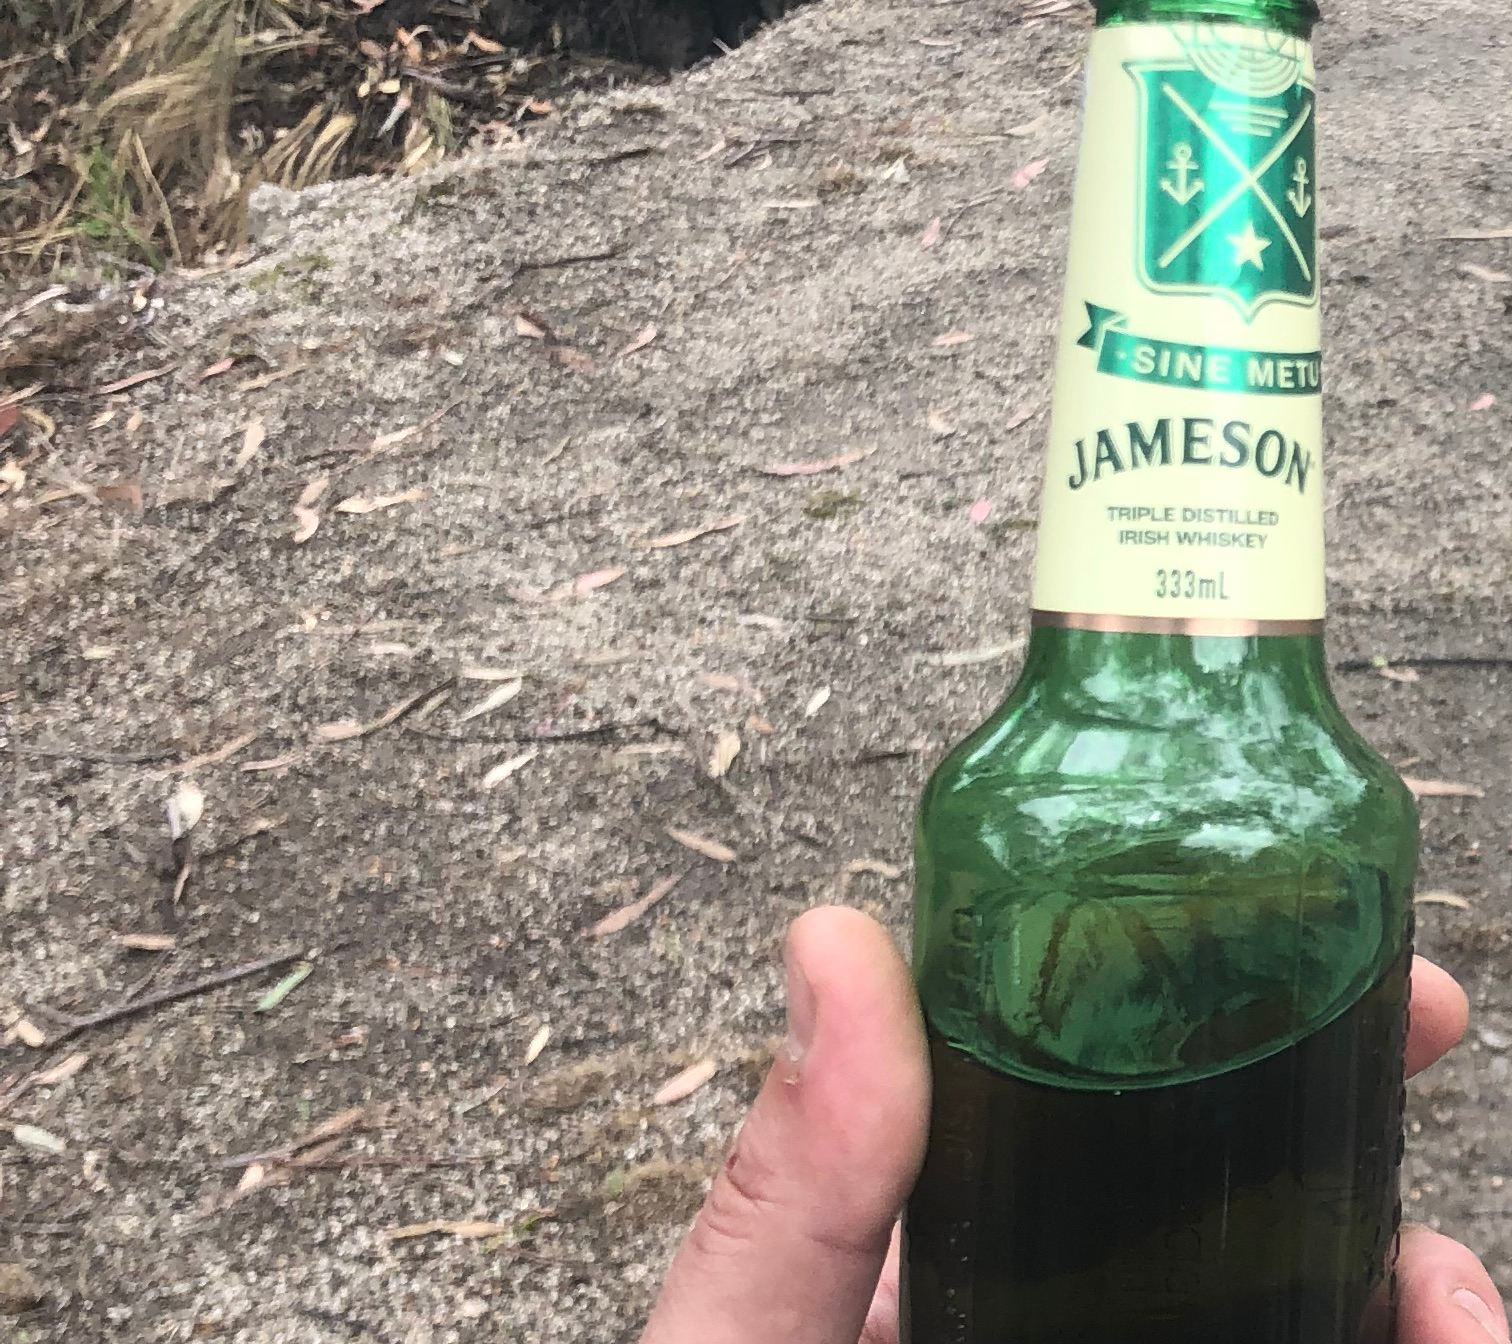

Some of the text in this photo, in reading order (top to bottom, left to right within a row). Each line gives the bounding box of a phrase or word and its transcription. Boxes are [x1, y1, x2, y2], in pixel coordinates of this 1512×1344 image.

[1130, 346, 1230, 384] SINE
[1068, 418, 1315, 494] JAMESON
[1107, 506, 1279, 526] TRIPLE DISTILLED
[1119, 530, 1268, 549] IRISH WHISKEY
[1155, 569, 1230, 600] 333mL
